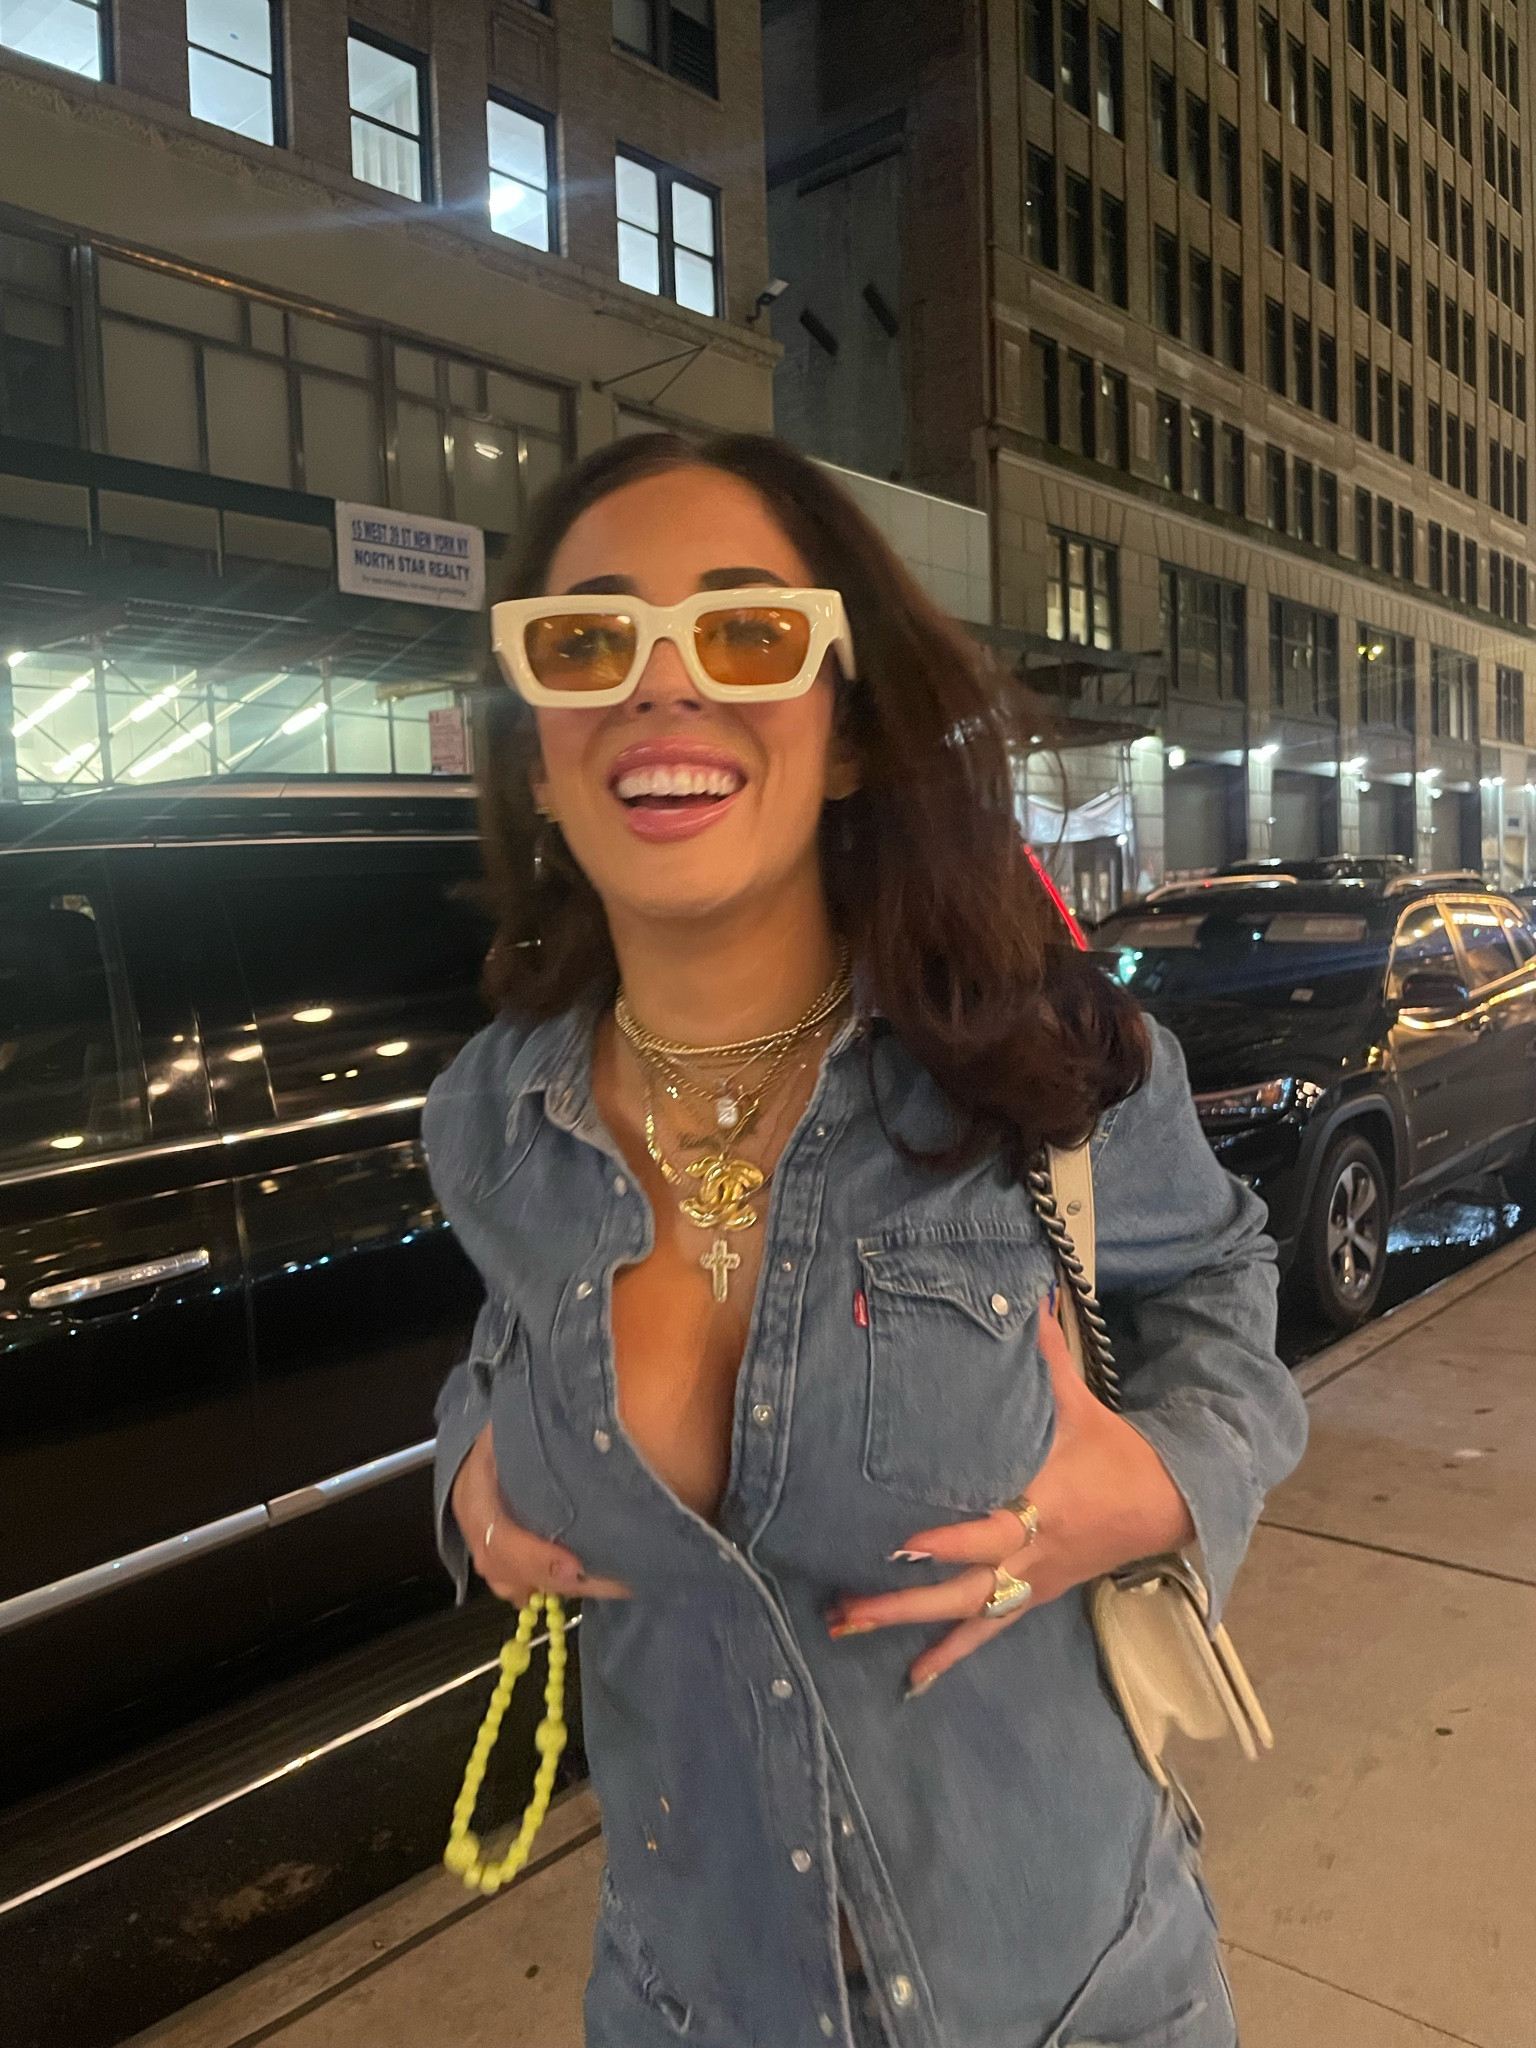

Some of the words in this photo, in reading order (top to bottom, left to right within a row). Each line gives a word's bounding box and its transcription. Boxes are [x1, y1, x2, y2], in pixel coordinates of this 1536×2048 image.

[364, 521, 387, 543] WEST
[413, 530, 431, 551] NEW
[434, 534, 455, 555] YORK
[354, 549, 395, 571] NORTH
[398, 555, 426, 575] STAR
[429, 560, 470, 581] REALTY
